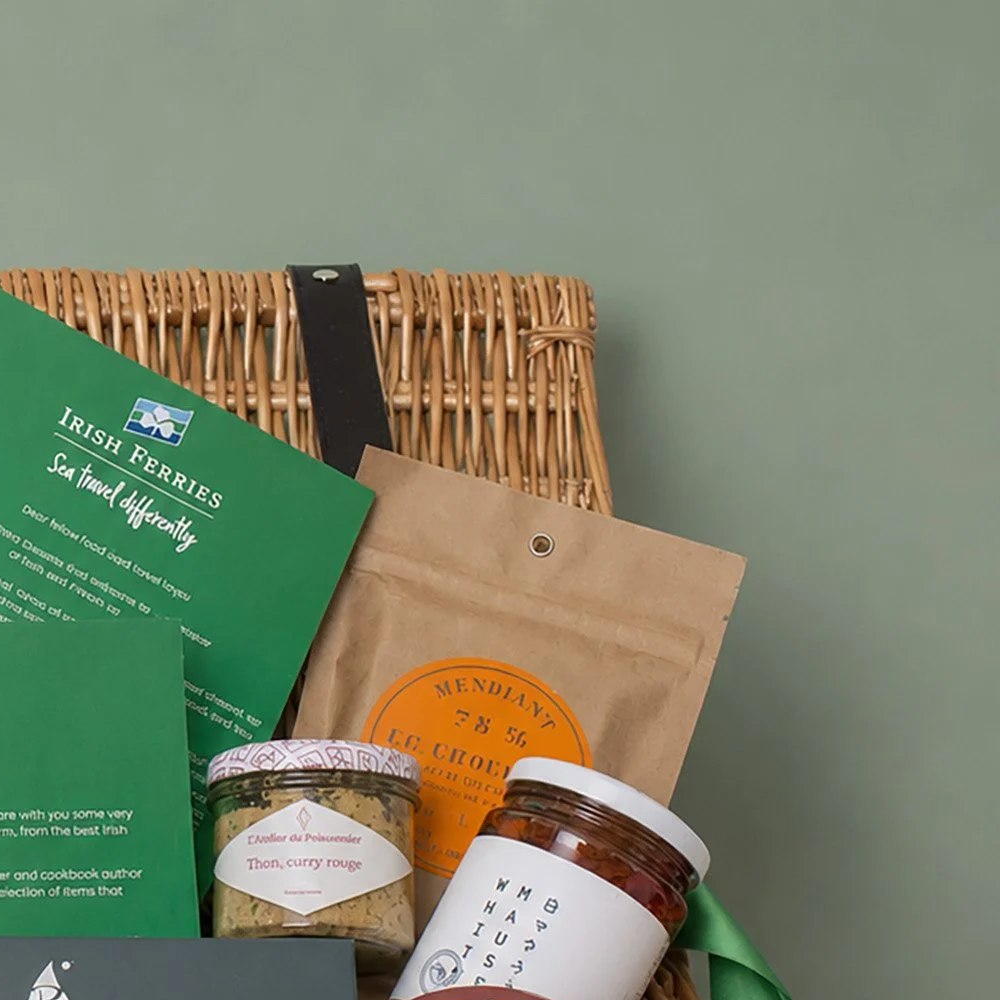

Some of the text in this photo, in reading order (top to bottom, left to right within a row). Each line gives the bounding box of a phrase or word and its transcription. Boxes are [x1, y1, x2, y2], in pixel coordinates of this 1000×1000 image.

[47, 452, 198, 553] Sea travel differently
[434, 677, 557, 731] MENDIANT
[19, 809, 45, 820] with
[47, 811, 70, 822] you
[72, 810, 105, 820] some
[107, 810, 134, 821] very
[20, 825, 49, 837] from
[50, 825, 71, 836] the
[73, 825, 100, 836] best
[246, 857, 363, 873] Thon, curry rouge
[13, 870, 38, 881] and
[40, 867, 99, 881] cookbook
[101, 868, 143, 880] author
[47, 886, 60, 897] of
[98, 885, 123, 896] that
